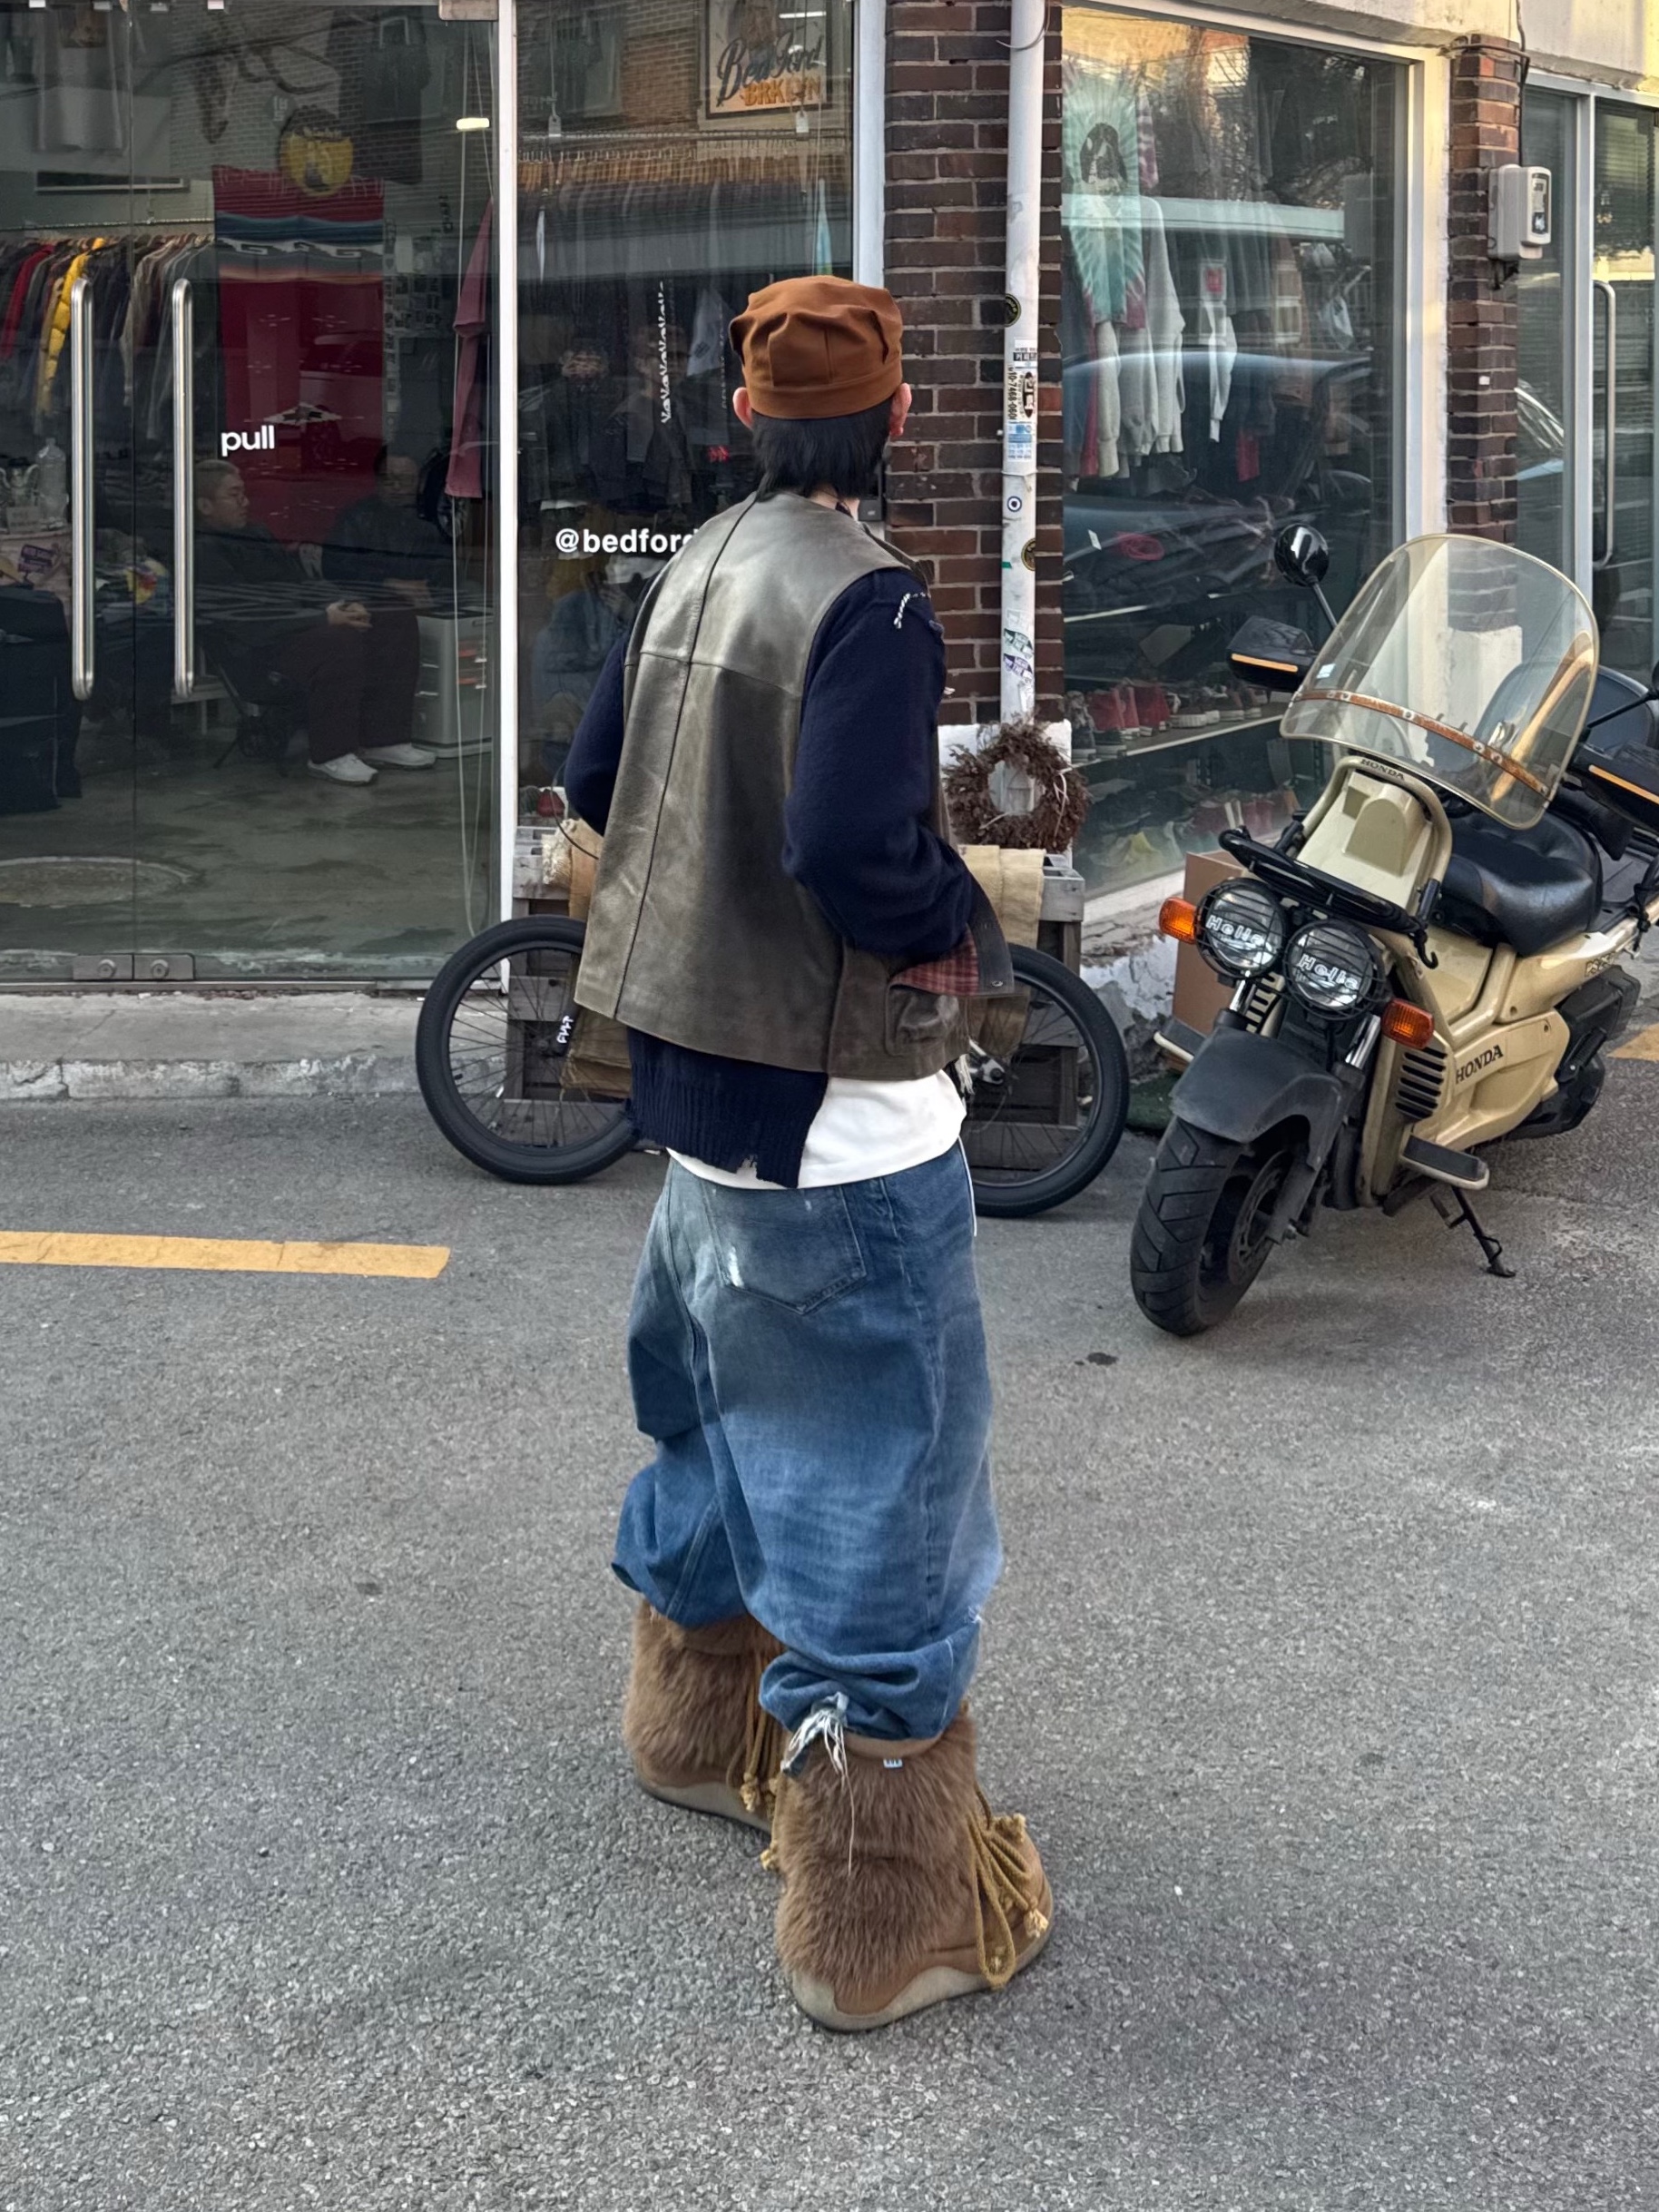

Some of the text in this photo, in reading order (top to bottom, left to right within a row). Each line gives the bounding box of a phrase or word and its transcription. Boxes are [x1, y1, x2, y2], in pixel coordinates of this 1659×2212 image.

[221, 425, 275, 457] pull
[555, 527, 700, 553] @bedfor
[1360, 758, 1405, 780] HONDA
[1455, 1044, 1504, 1085] HONDA
